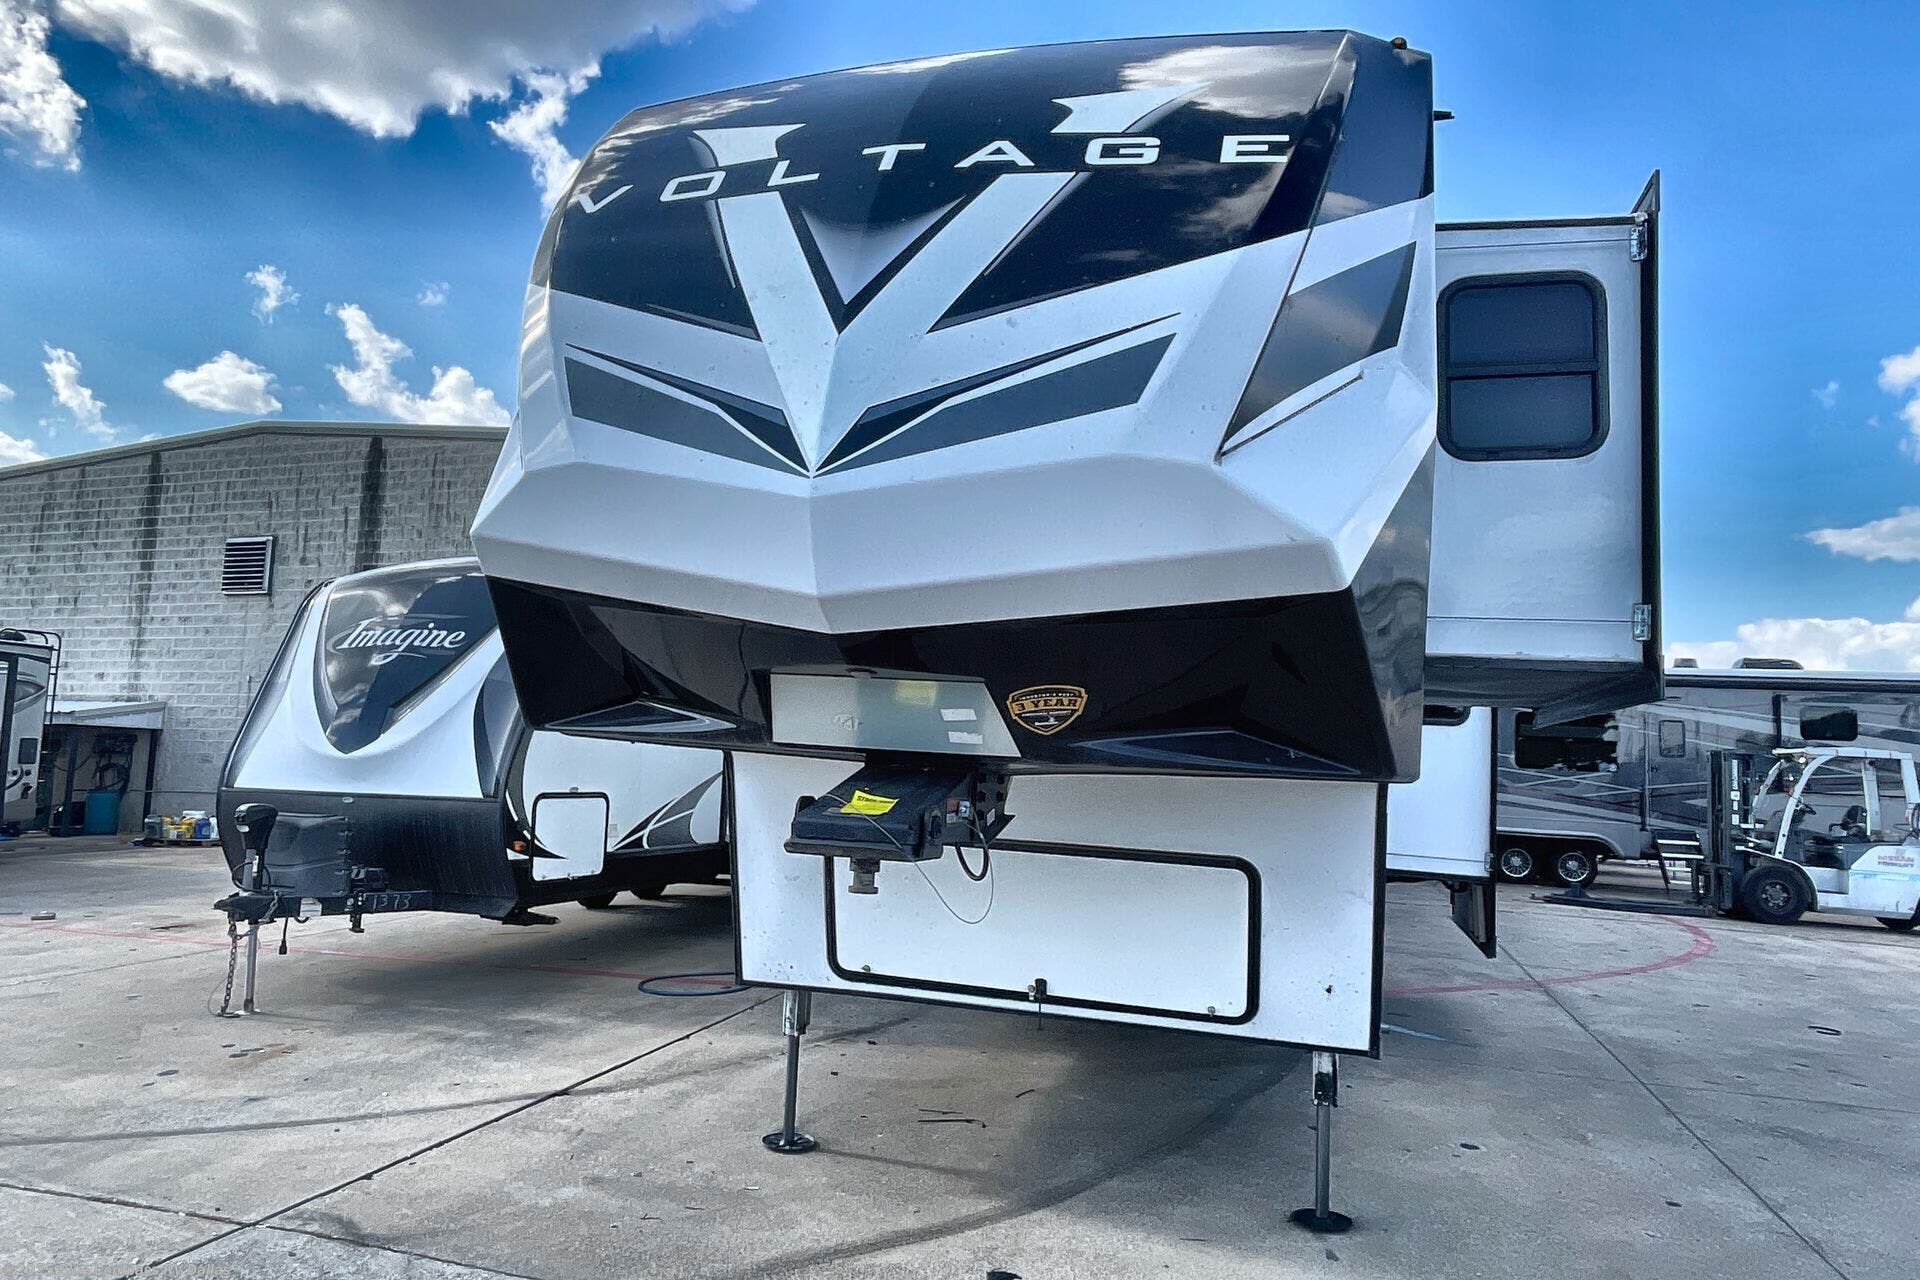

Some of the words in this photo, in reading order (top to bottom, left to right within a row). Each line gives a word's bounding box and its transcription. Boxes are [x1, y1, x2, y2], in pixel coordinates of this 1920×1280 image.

[576, 134, 1290, 213] VOLTAGE
[336, 615, 467, 665] Imagine
[1016, 703, 1026, 712] 3
[1030, 698, 1077, 709] YEAR
